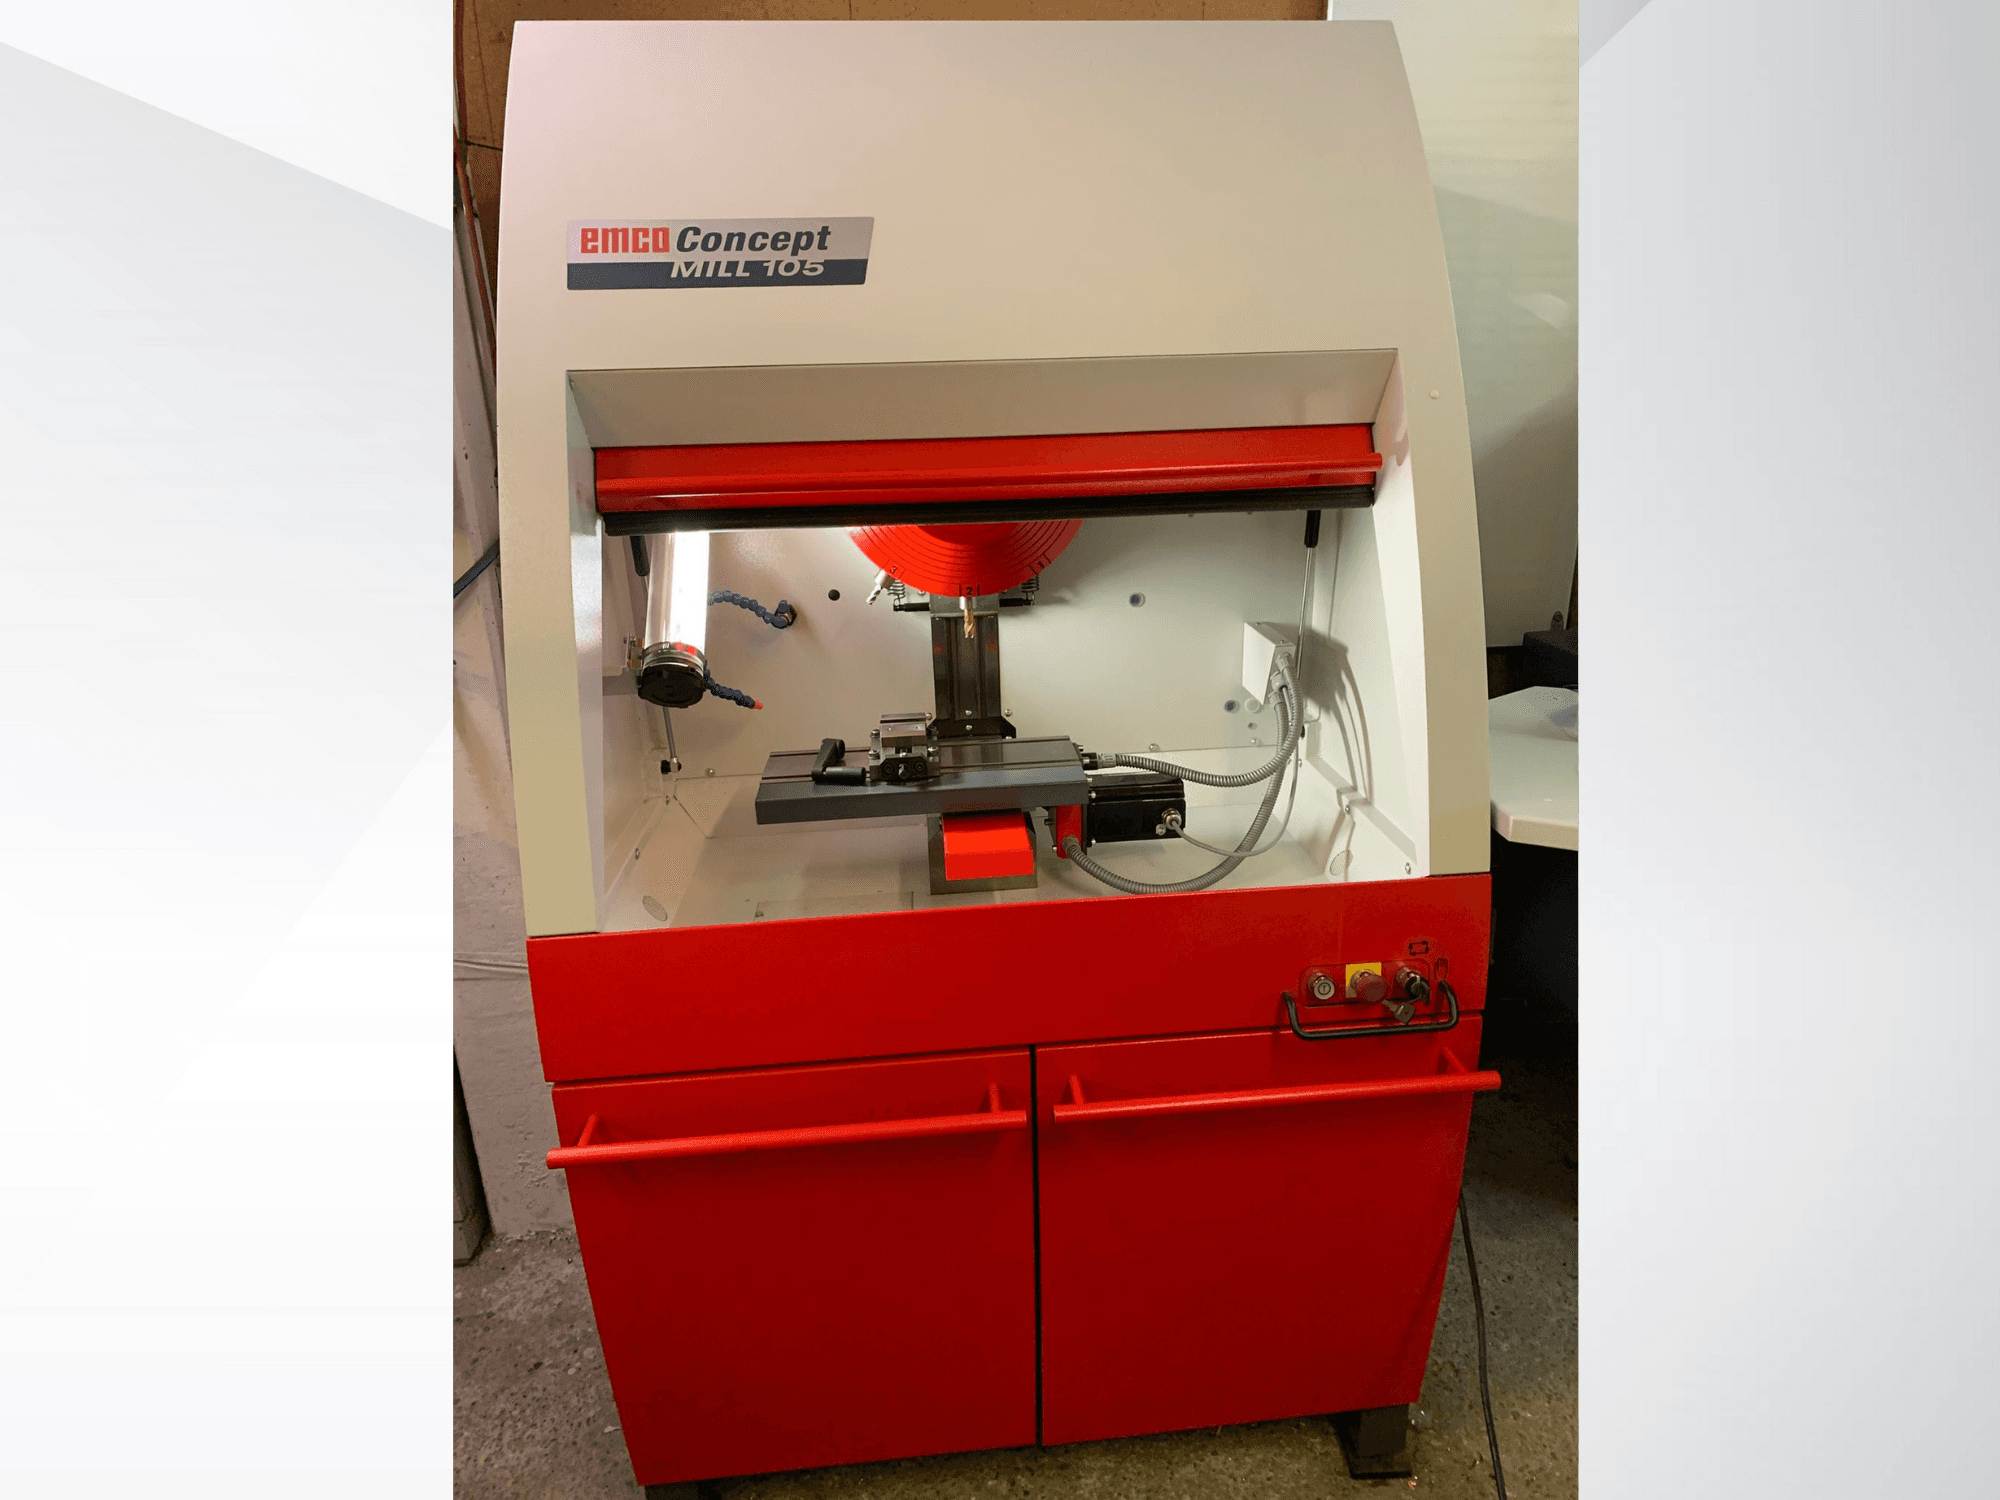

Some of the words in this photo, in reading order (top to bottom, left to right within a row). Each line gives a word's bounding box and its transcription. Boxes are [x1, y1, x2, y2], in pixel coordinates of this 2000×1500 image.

[580, 226, 670, 254] emco
[676, 225, 831, 256] Concept
[670, 260, 751, 278] MILL
[762, 259, 825, 277] 105
[965, 586, 974, 595] 2
